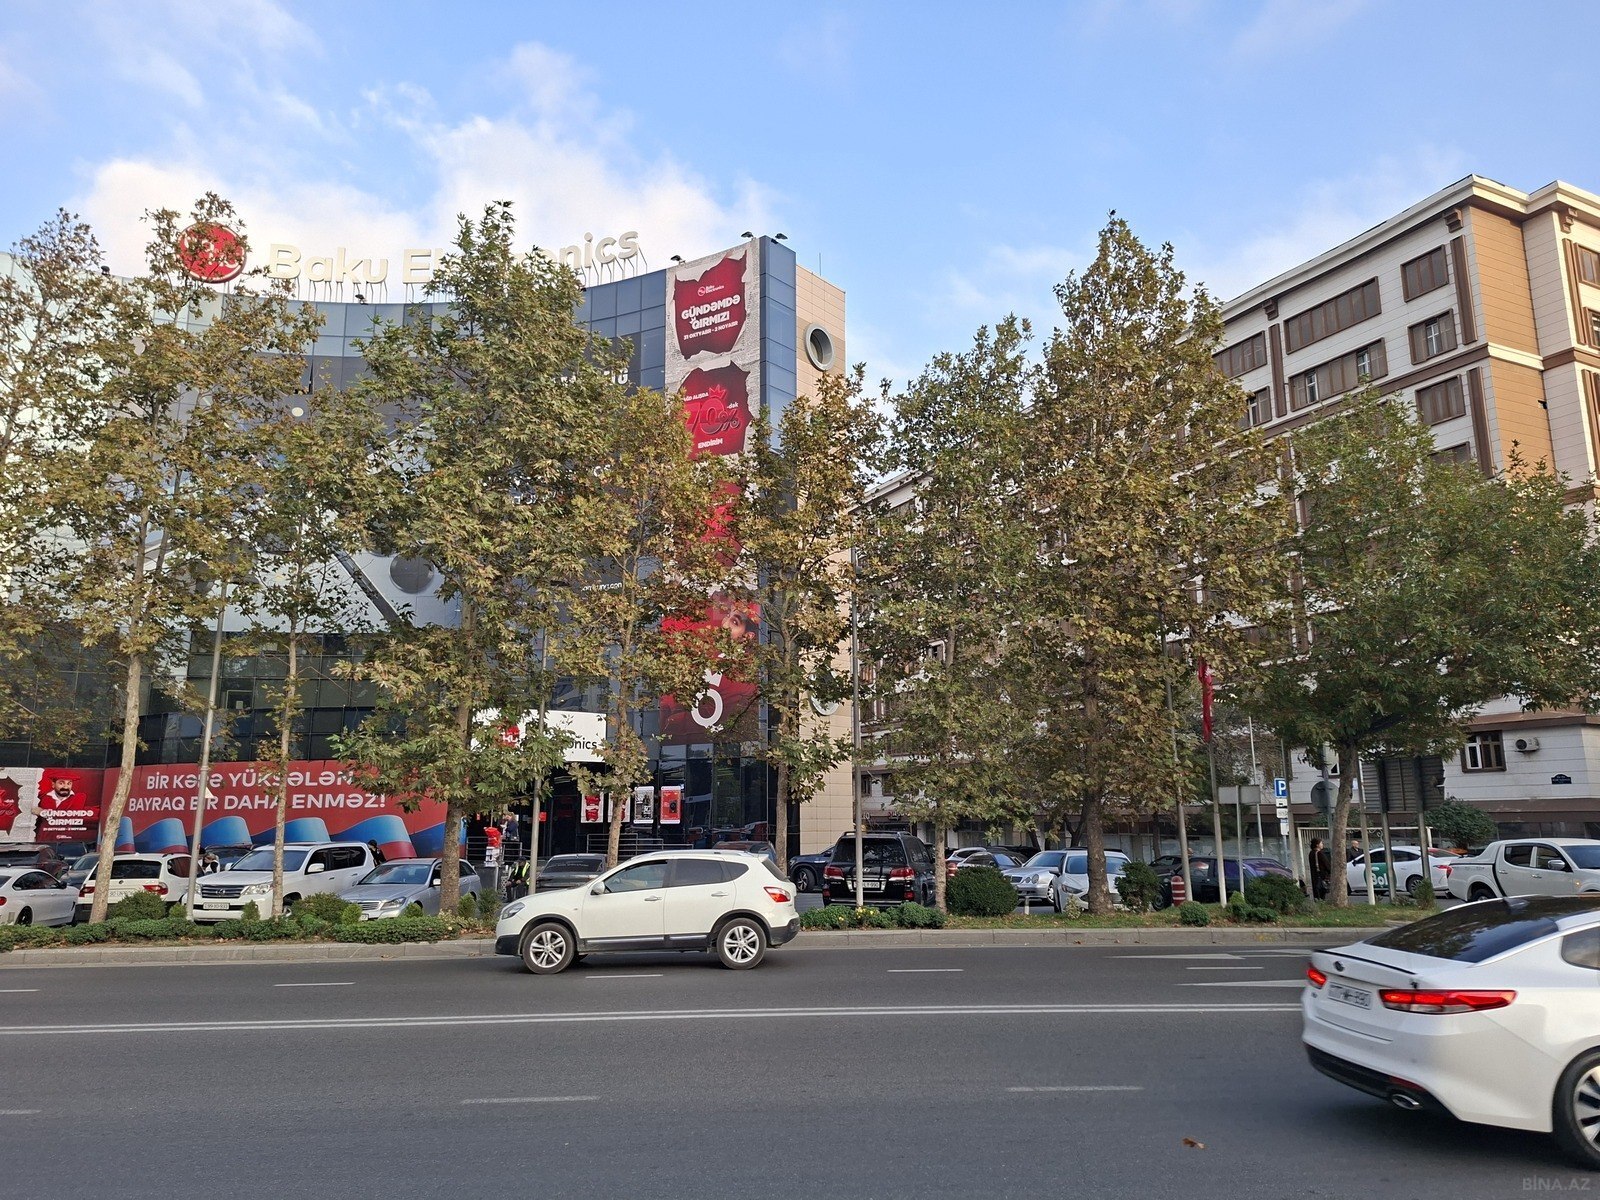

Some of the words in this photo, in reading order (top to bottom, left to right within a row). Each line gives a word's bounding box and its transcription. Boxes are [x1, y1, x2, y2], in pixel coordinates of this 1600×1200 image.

[267, 243, 389, 285] Baku
[681, 294, 741, 320] GÜNDƏMDƏ
[147, 771, 169, 790] BİR
[1278, 780, 1287, 796] P
[129, 796, 185, 812] BAYRAQ
[292, 793, 386, 809] ENMƏZ!
